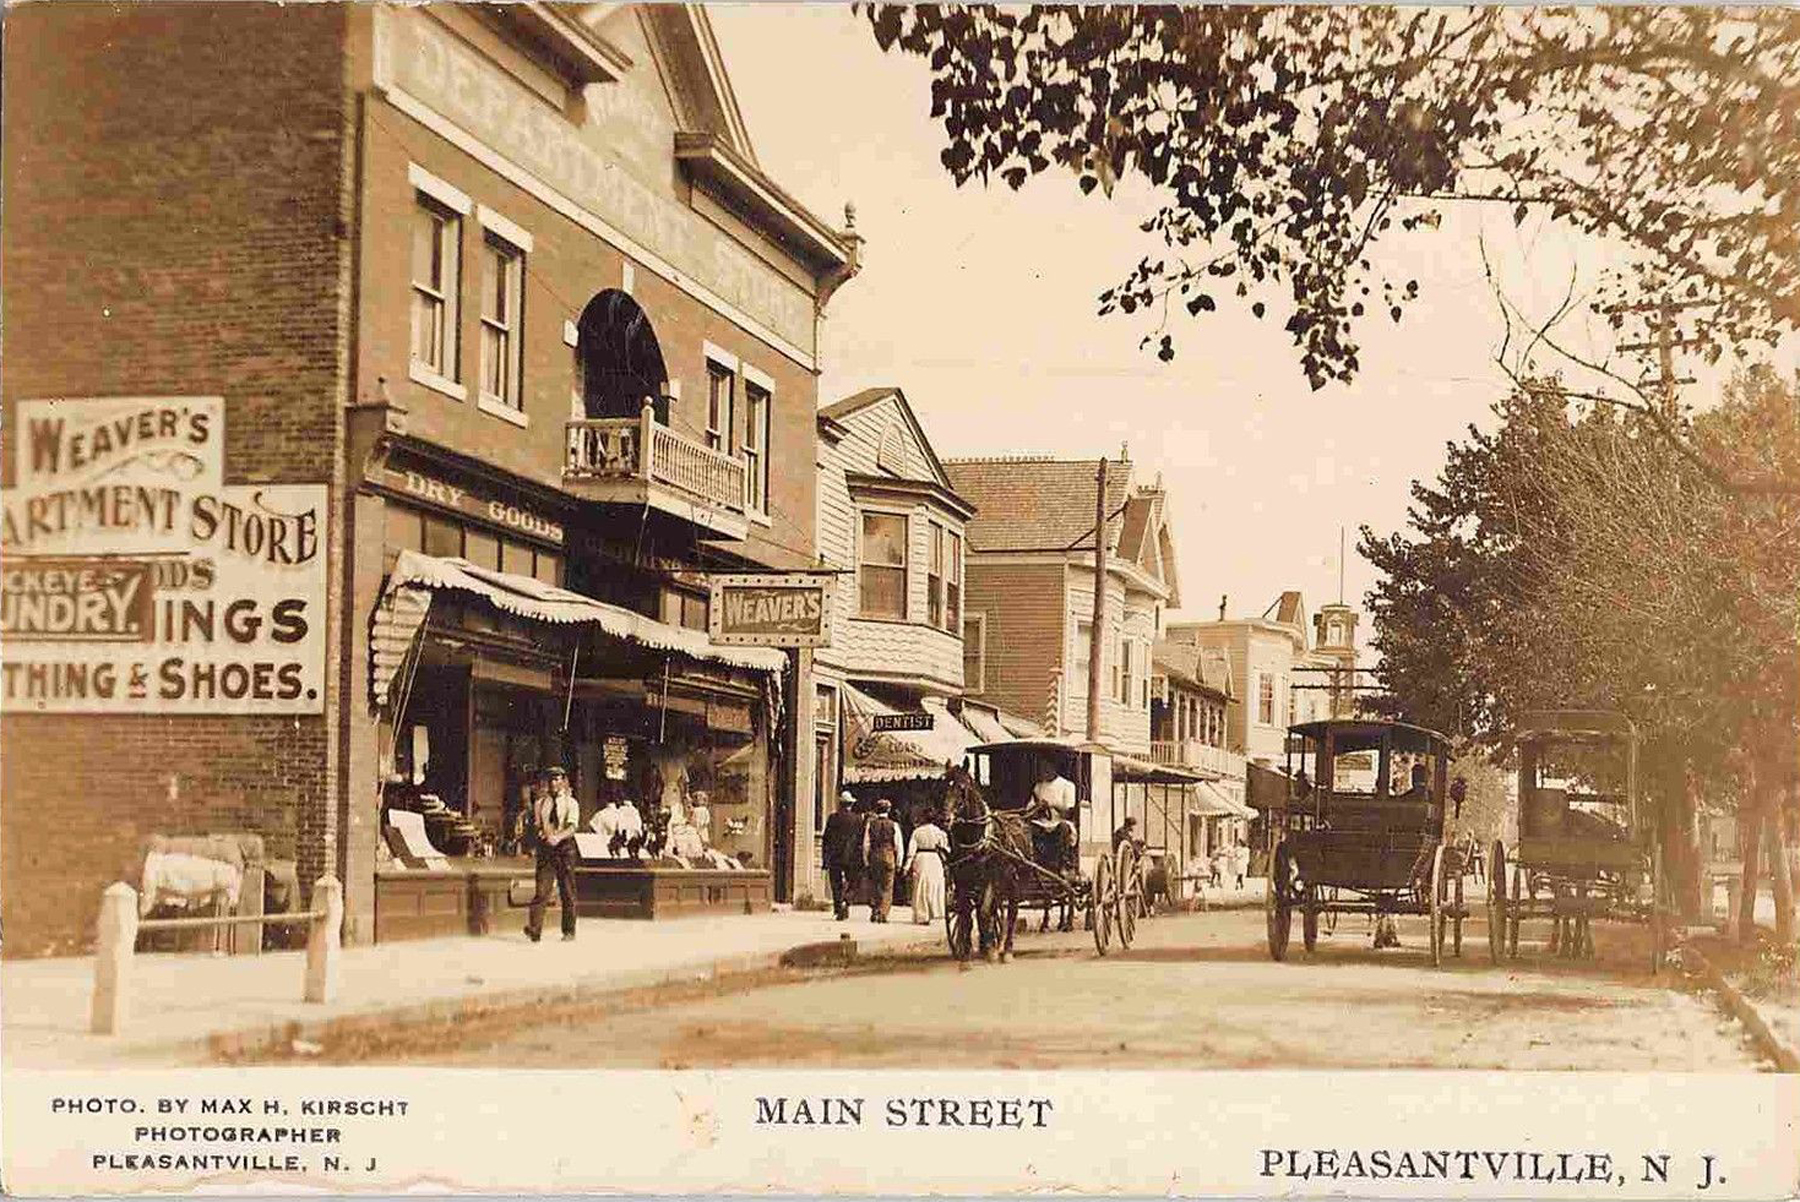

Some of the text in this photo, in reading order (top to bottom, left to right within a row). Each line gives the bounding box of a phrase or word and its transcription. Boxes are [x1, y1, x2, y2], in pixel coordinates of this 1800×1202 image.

[28, 407, 210, 474] WEAVER'S
[191, 490, 319, 565] STORE
[406, 471, 563, 544] DRY GOODS
[2, 657, 318, 700] THING & SHOES.
[875, 715, 932, 729] DENTIST
